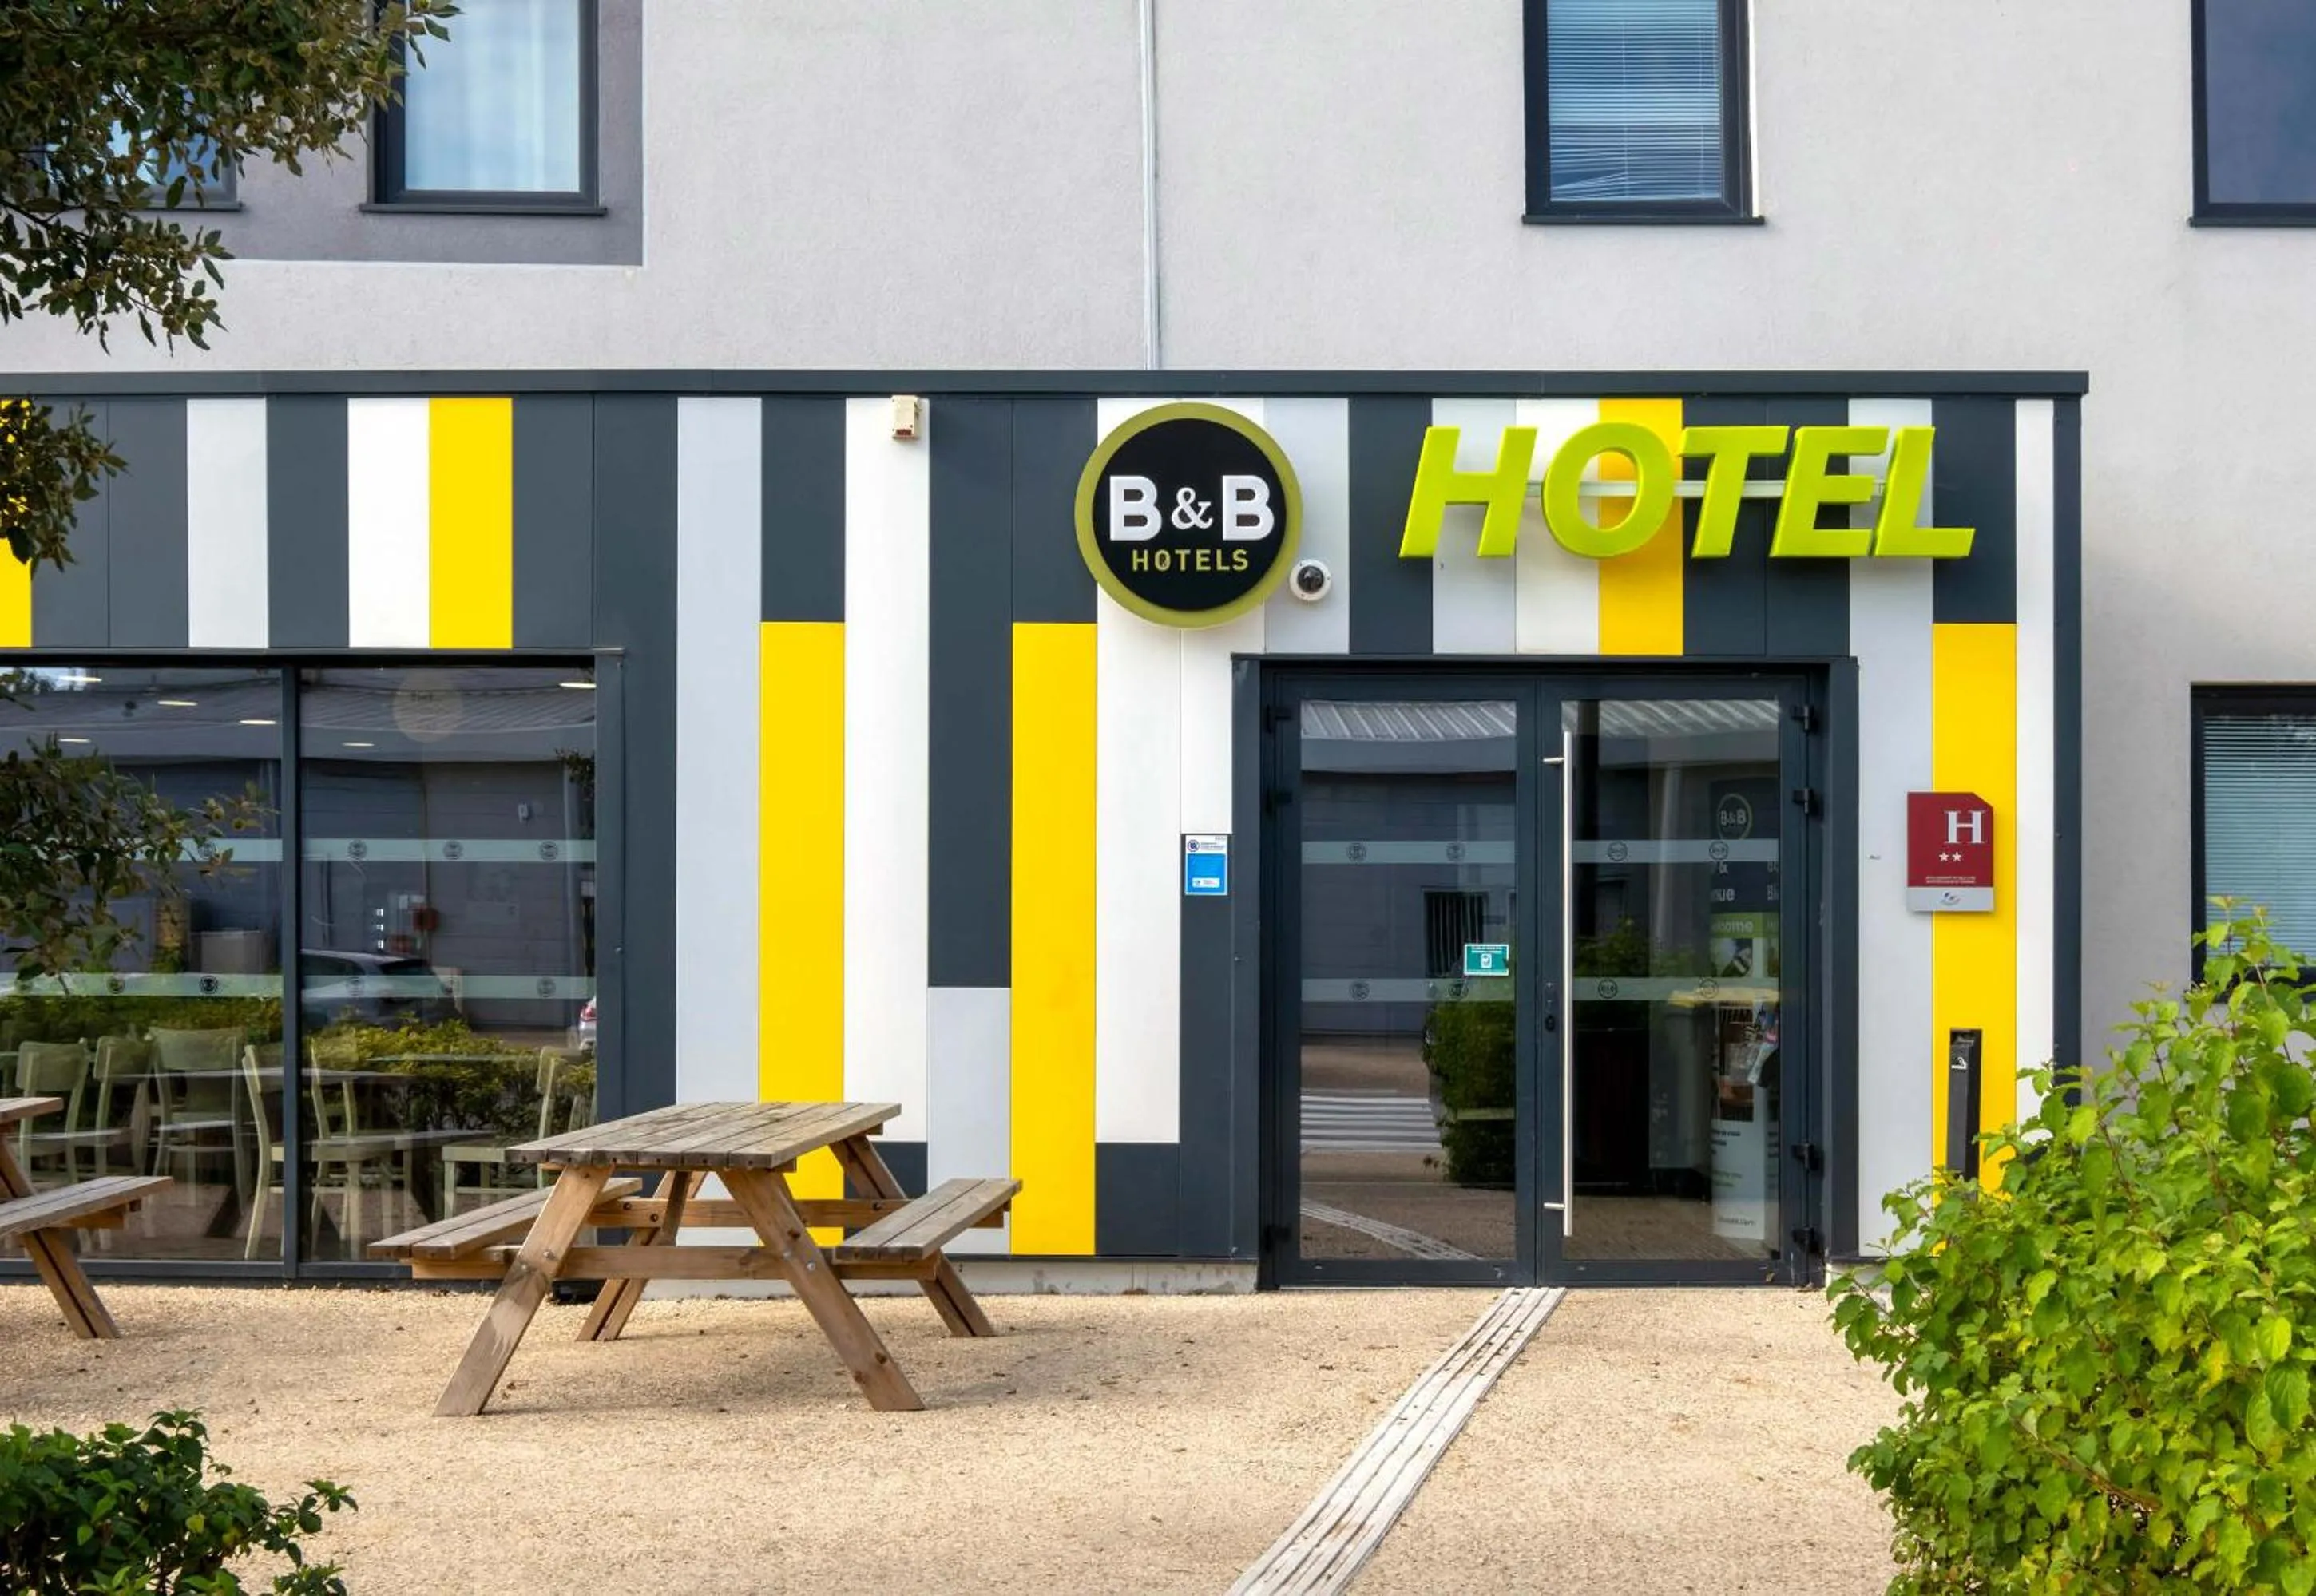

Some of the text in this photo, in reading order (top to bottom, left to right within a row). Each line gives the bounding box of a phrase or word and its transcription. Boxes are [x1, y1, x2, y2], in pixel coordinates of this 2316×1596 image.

[1109, 474, 1275, 541] B&B
[1398, 422, 1977, 559] HOTEL
[1131, 549, 1250, 572] HOTELS
[1944, 810, 1985, 844] H
